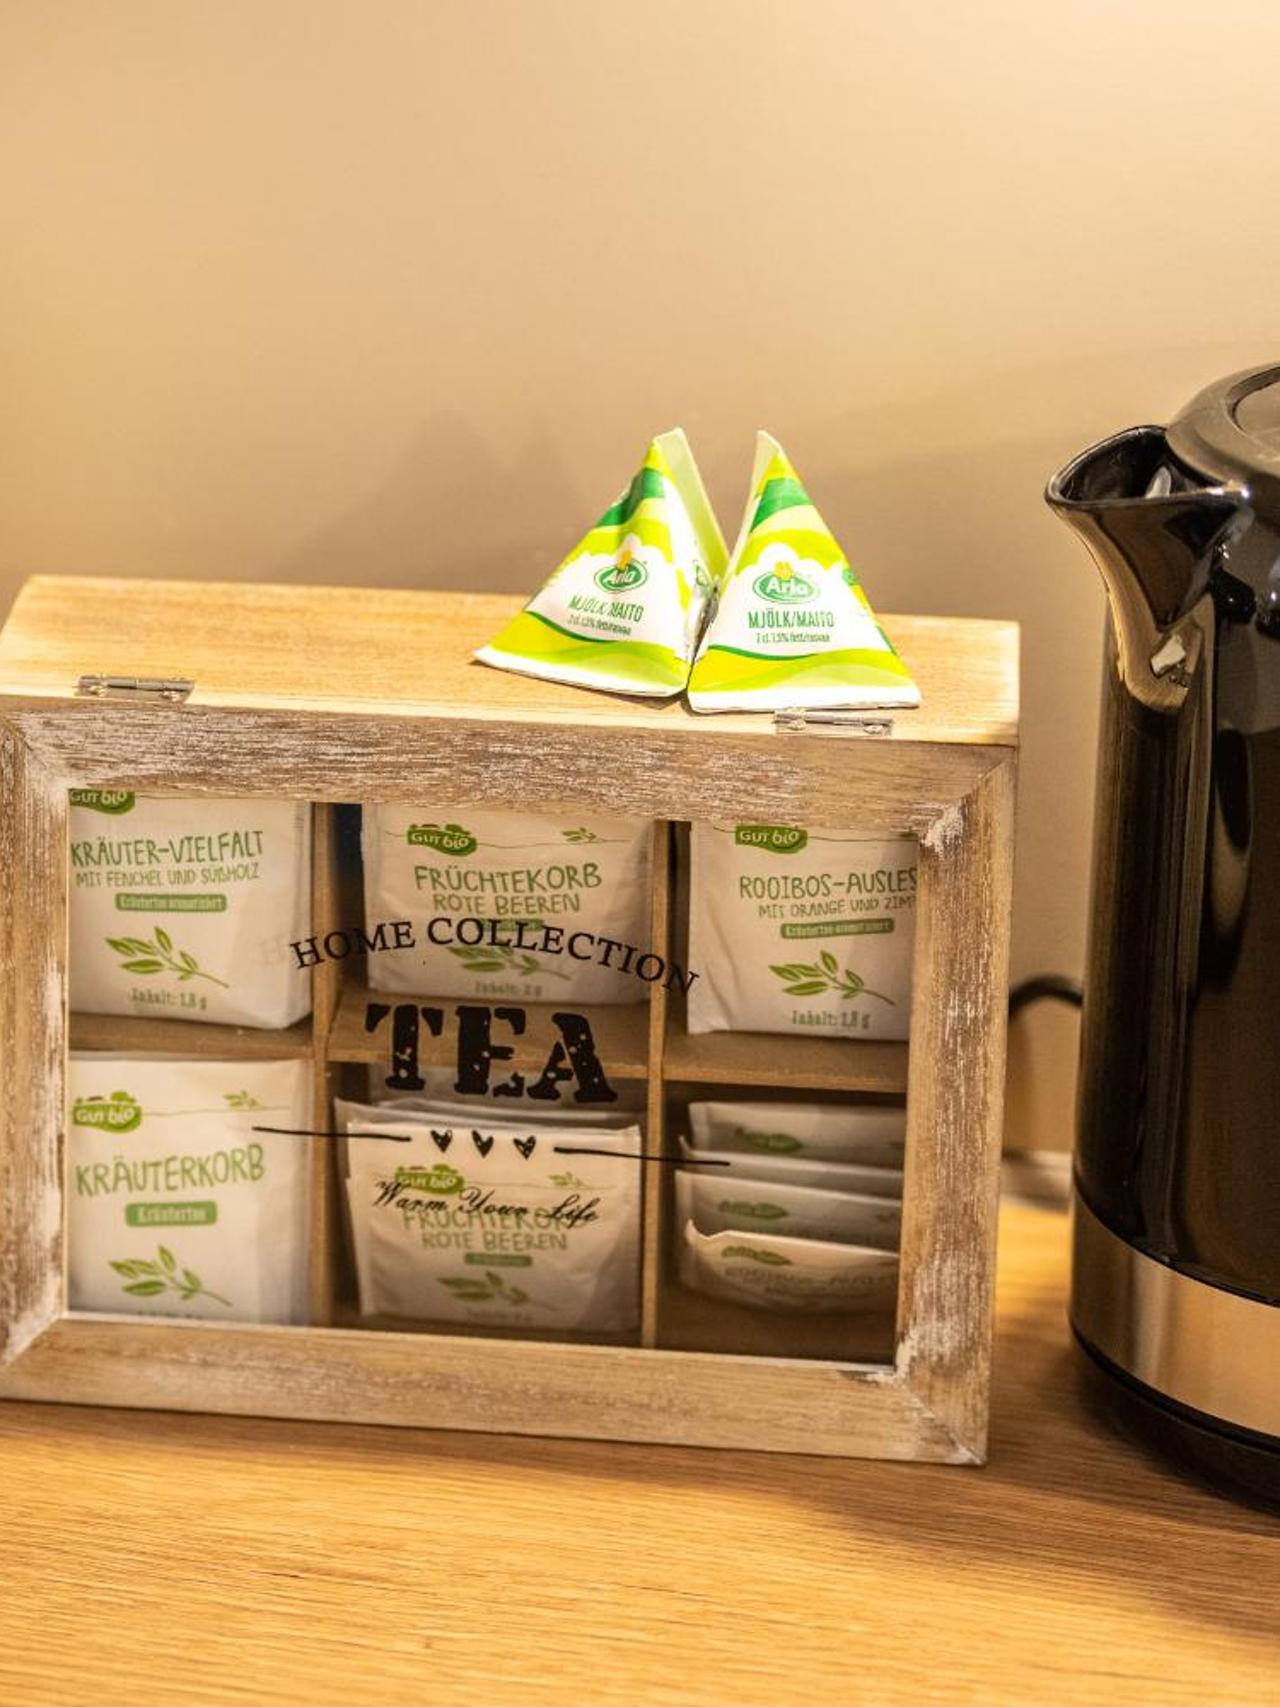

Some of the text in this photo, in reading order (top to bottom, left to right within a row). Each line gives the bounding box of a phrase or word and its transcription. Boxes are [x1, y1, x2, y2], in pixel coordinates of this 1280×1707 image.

[765, 575, 809, 597] Arla
[748, 607, 834, 629] MJÖLK/MAITO
[411, 832, 440, 845] GUT
[739, 829, 769, 843] GUT
[70, 830, 264, 868] KRÄUTER-VIELFALT
[76, 871, 102, 888] MIT
[106, 868, 163, 888] FENCHEL
[167, 867, 196, 885] UND
[414, 861, 602, 893] FRÜCHTEKORB
[432, 892, 581, 916] ROTE BEEREN
[758, 903, 785, 919] MIT
[790, 900, 847, 917] ORANGE
[850, 896, 879, 912] UND
[289, 917, 700, 996] HOME COLLECTION
[365, 1003, 619, 1103] TEA
[75, 1143, 265, 1197] KRÄUTERKORB
[373, 1179, 600, 1229] Warm Your Life
[421, 1230, 567, 1251] ROTE BEEREN
